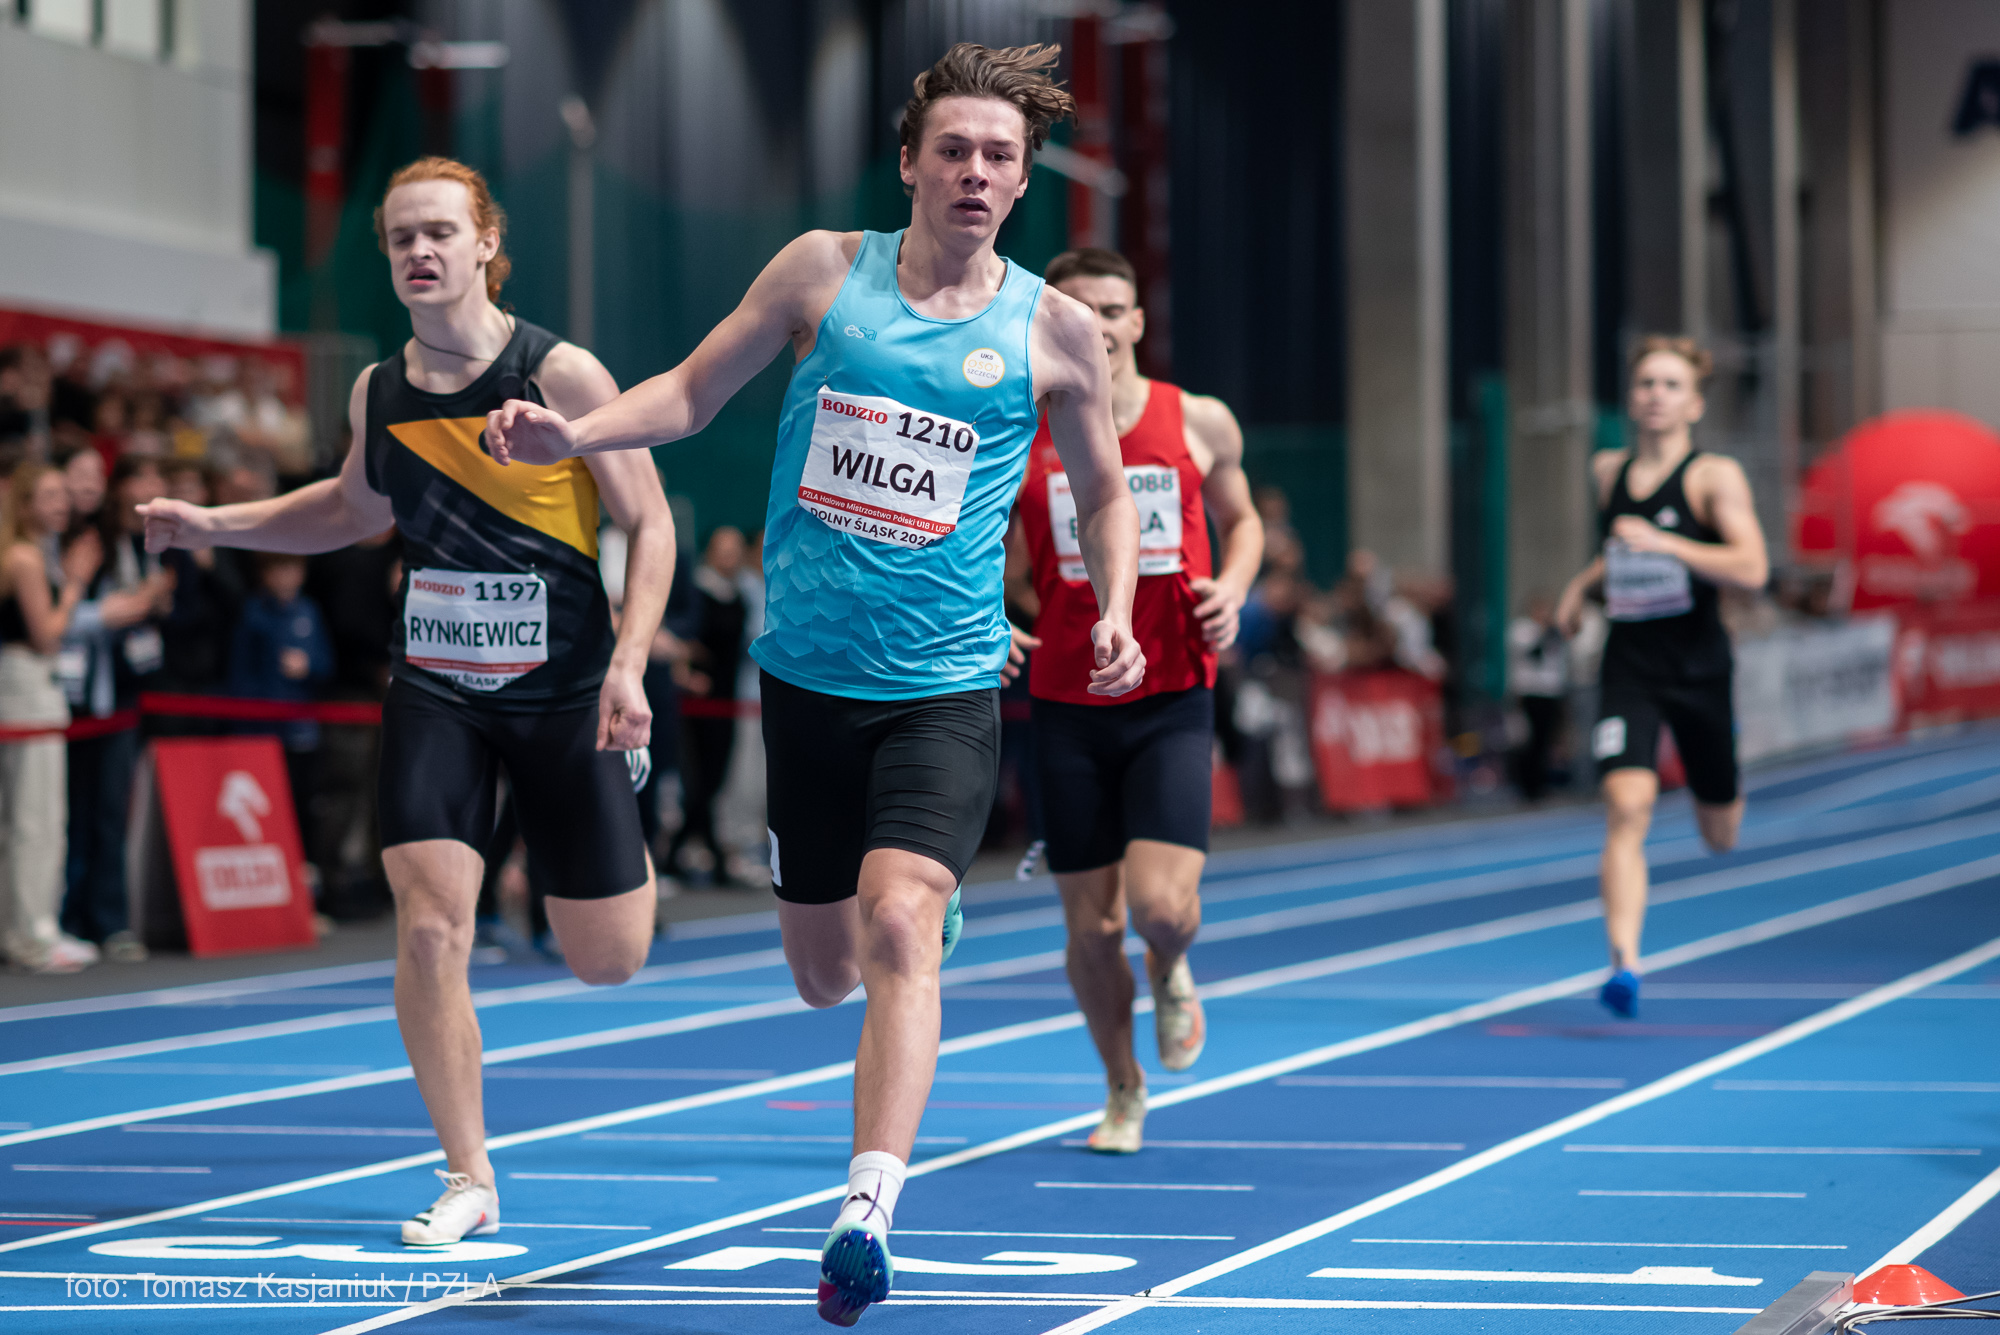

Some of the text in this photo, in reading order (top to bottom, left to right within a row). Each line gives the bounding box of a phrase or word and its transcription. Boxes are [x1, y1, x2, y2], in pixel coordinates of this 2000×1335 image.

[967, 359, 1000, 374] OSOT
[980, 352, 994, 361] UKS
[966, 368, 998, 380] SZCZECIN
[821, 398, 974, 453] BODZIO 1210
[832, 444, 936, 502] WILGA
[1129, 473, 1174, 494] 088
[802, 489, 819, 501] PZLA
[820, 494, 846, 508] Halowe
[846, 502, 892, 520] Mistrzostwa
[892, 513, 916, 526] Polski
[916, 520, 931, 530] U18
[935, 525, 951, 534] U20
[810, 506, 852, 528] DOLNY
[853, 517, 898, 540] ŚLĄSK
[413, 579, 541, 601] BODZIO 1197
[410, 616, 542, 647] RYNKIEWICZ
[463, 672, 500, 688] ŚLĄSK
